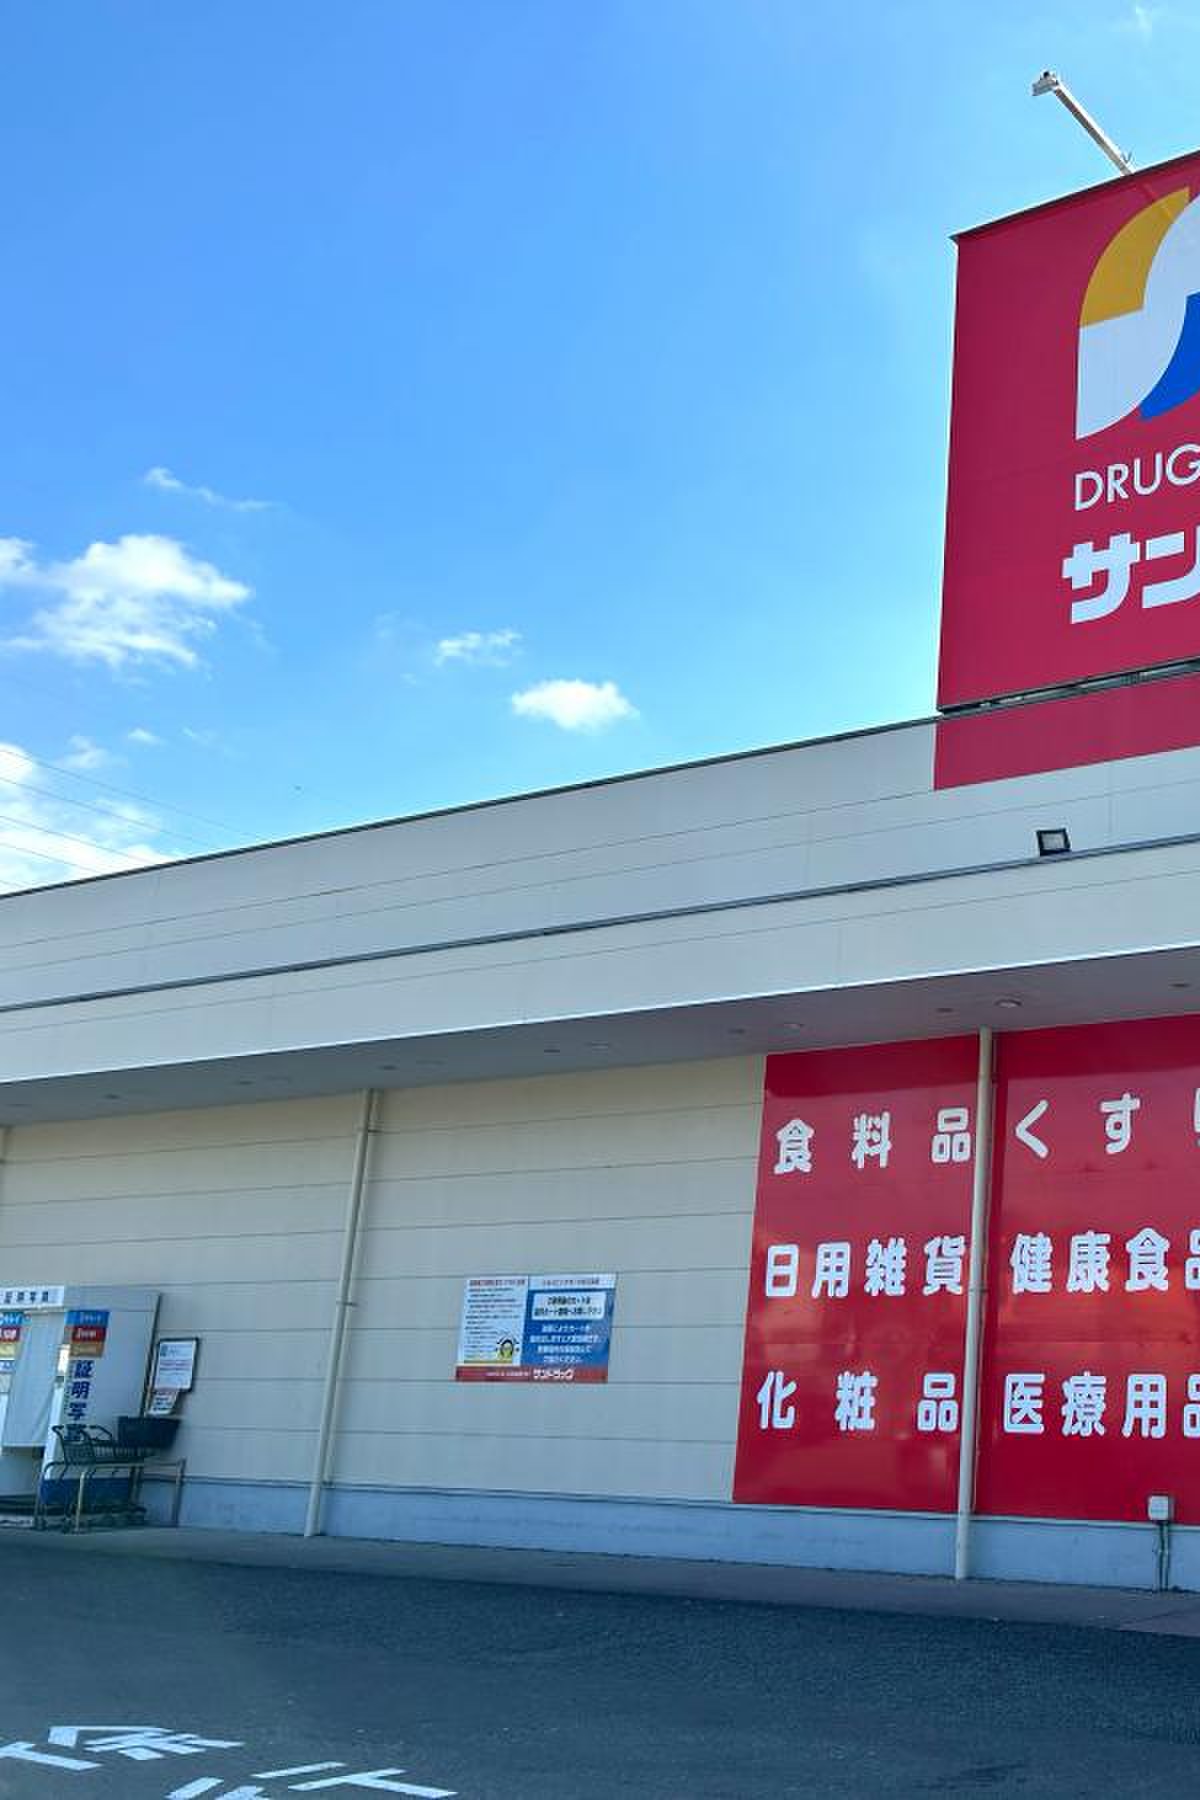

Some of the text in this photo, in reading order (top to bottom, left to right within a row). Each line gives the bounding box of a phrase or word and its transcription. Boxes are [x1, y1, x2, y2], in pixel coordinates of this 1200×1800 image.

[773, 1107, 971, 1175] 食料品
[765, 1235, 966, 1298] 日用雑貨
[756, 1371, 959, 1433] 化粧品
